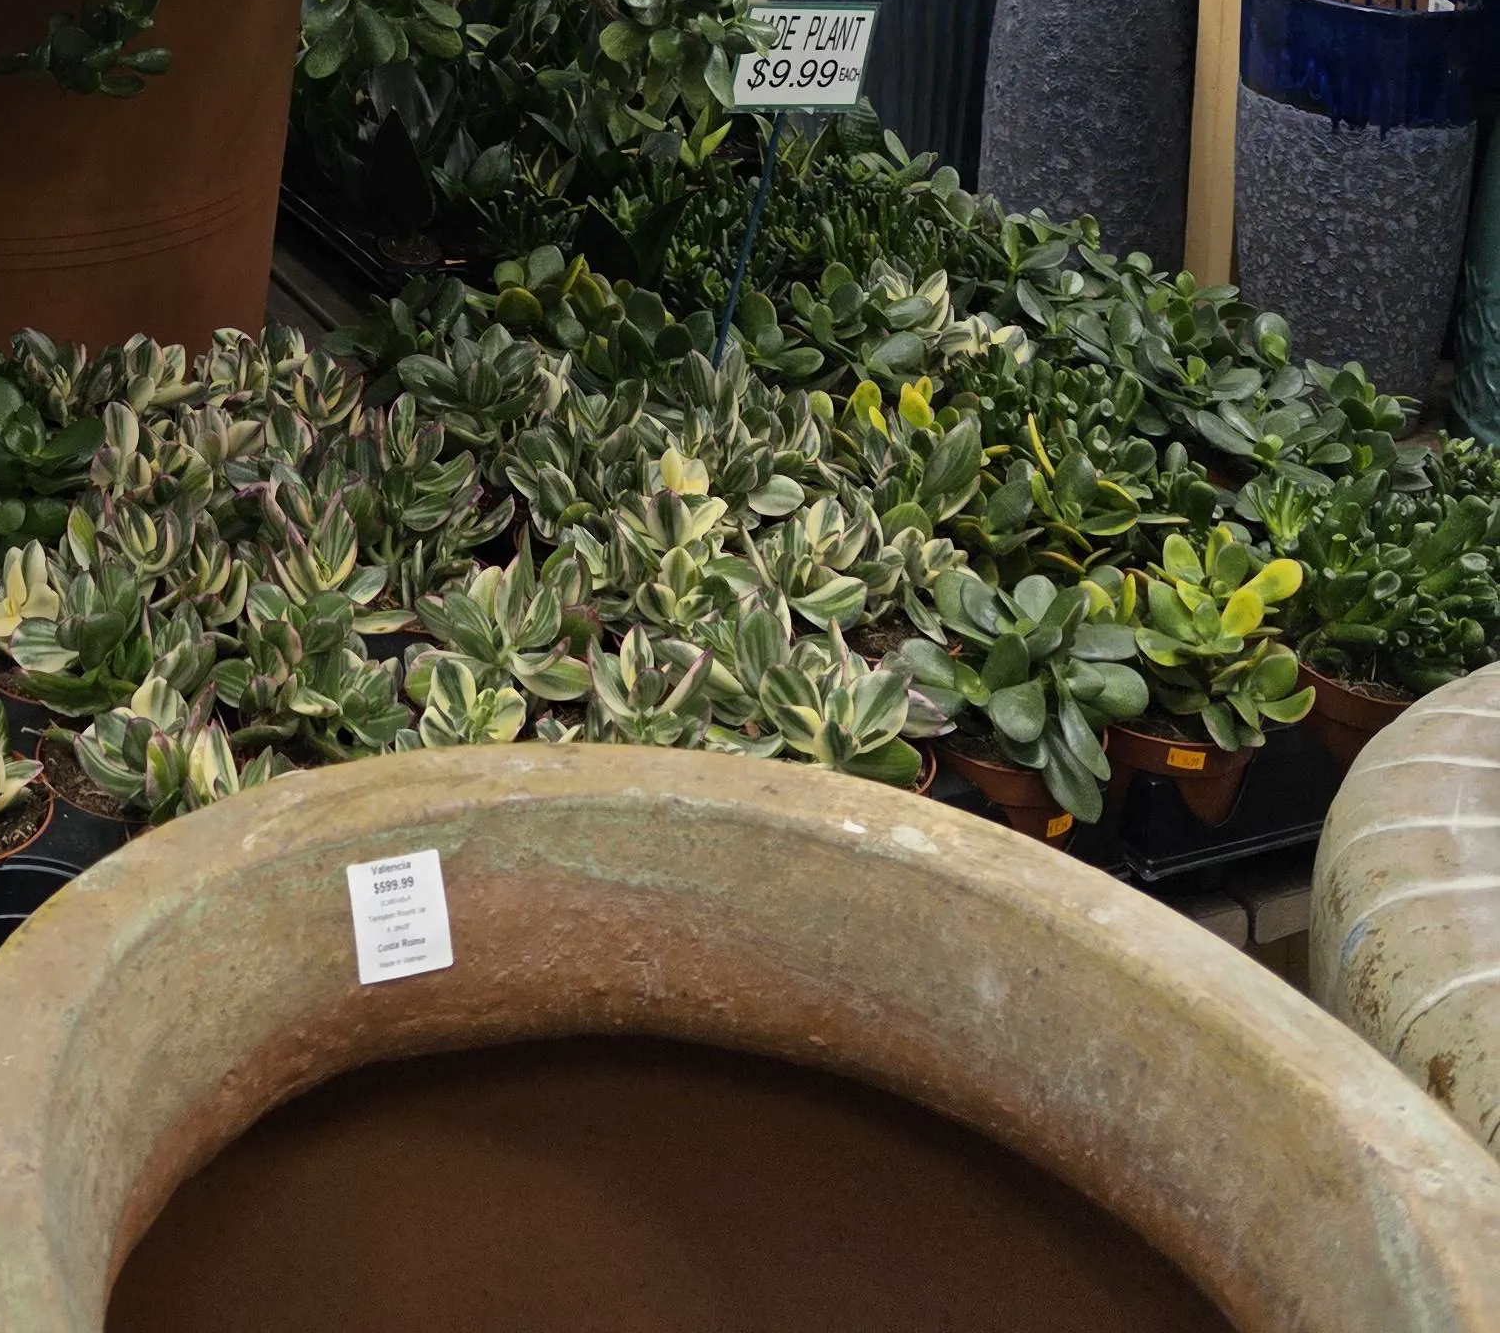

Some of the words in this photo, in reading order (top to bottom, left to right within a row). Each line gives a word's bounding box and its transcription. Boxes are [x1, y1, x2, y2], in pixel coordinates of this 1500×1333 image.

[762, 15, 801, 51] DE
[803, 15, 866, 51] PLANT
[747, 58, 839, 91] $9.99
